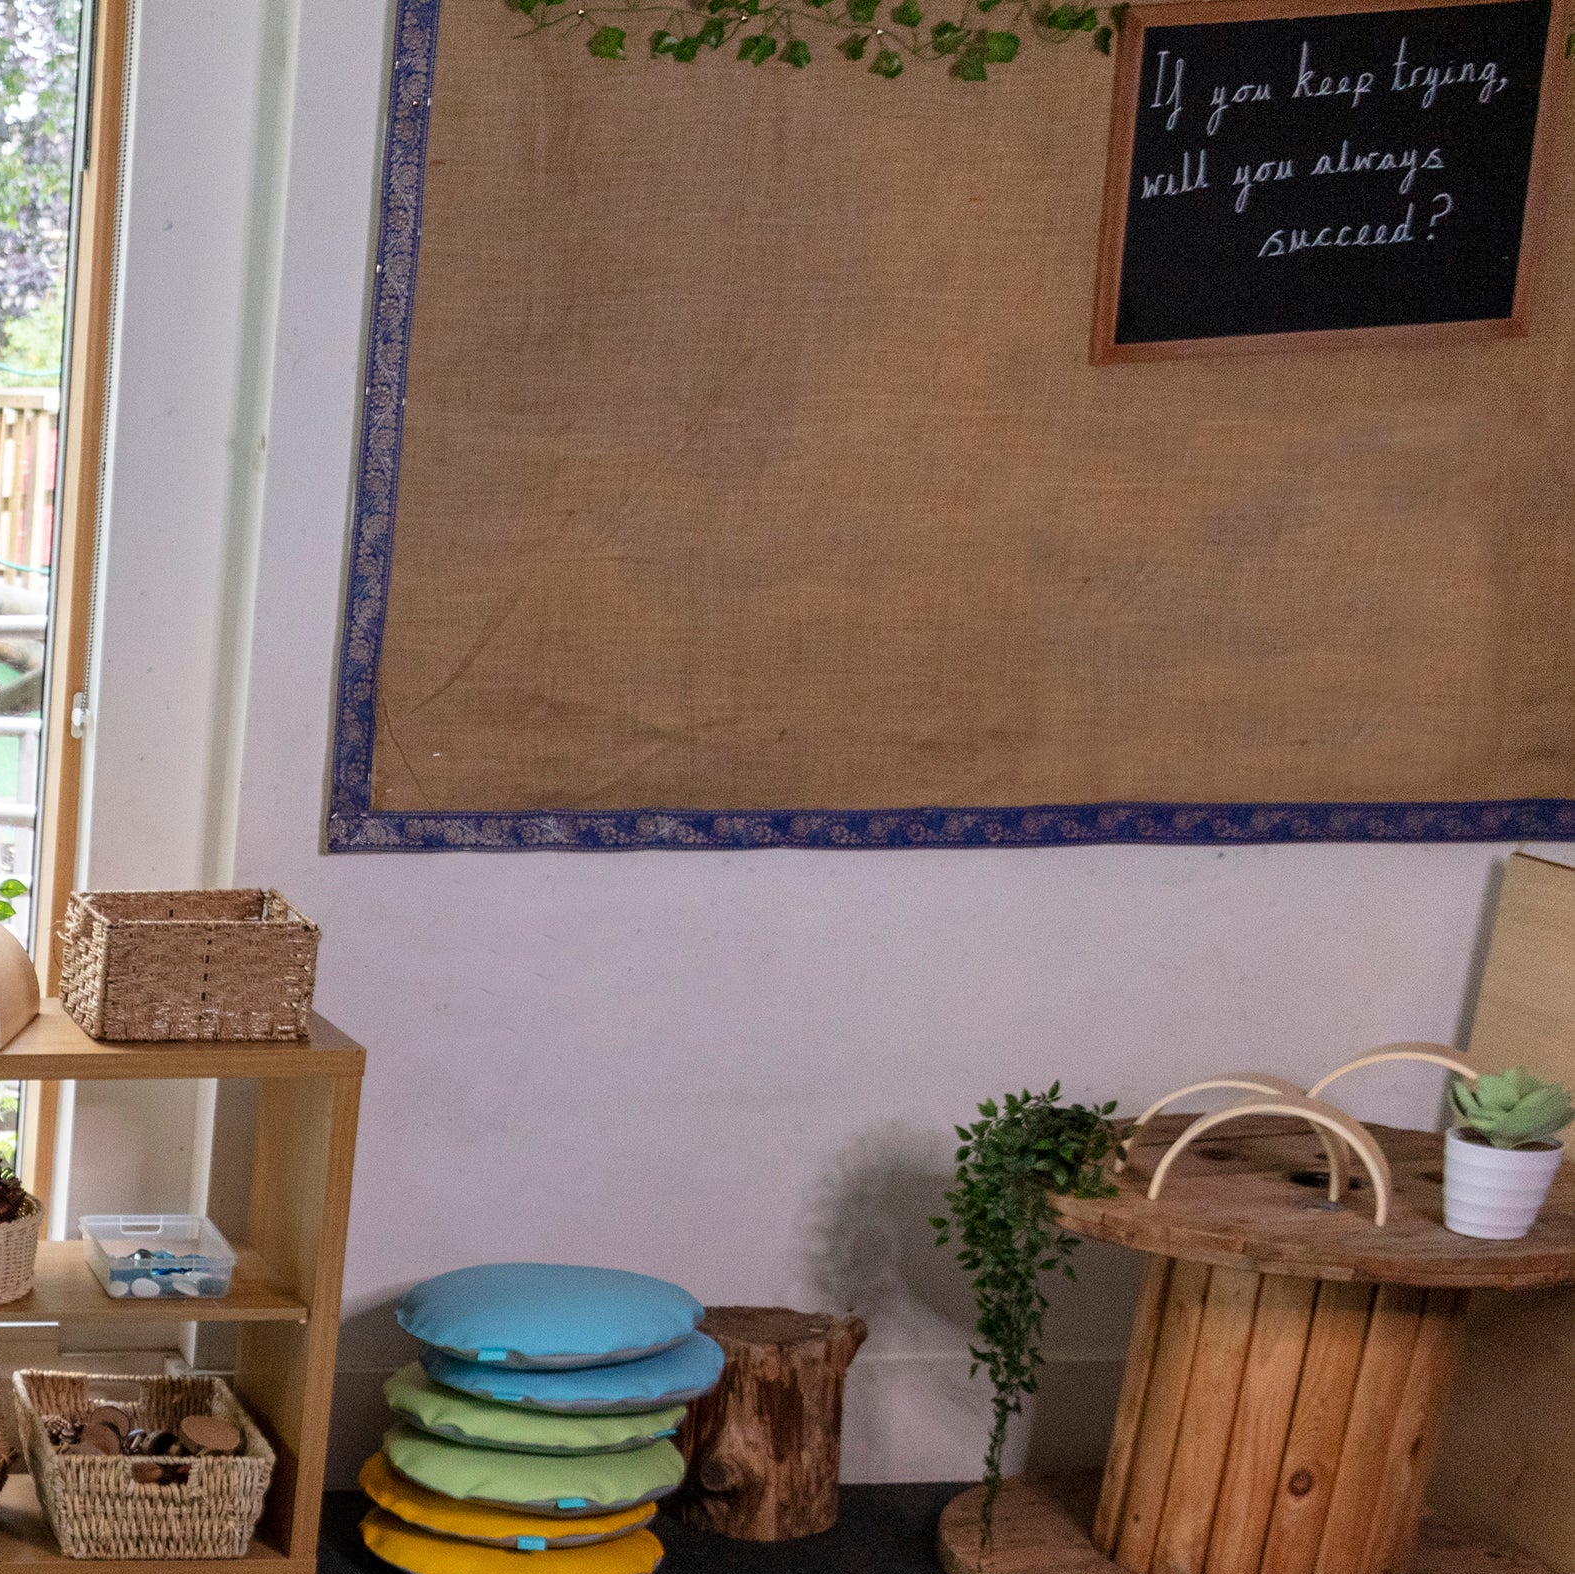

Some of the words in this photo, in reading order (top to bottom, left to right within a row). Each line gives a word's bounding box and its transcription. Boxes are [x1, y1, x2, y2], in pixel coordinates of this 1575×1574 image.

[1150, 50, 1186, 131] If
[1207, 84, 1272, 135] you
[1292, 41, 1372, 108] keep
[1391, 36, 1508, 109] trying,
[1141, 149, 1208, 201] will
[1232, 159, 1294, 213] you
[1310, 140, 1444, 194] always
